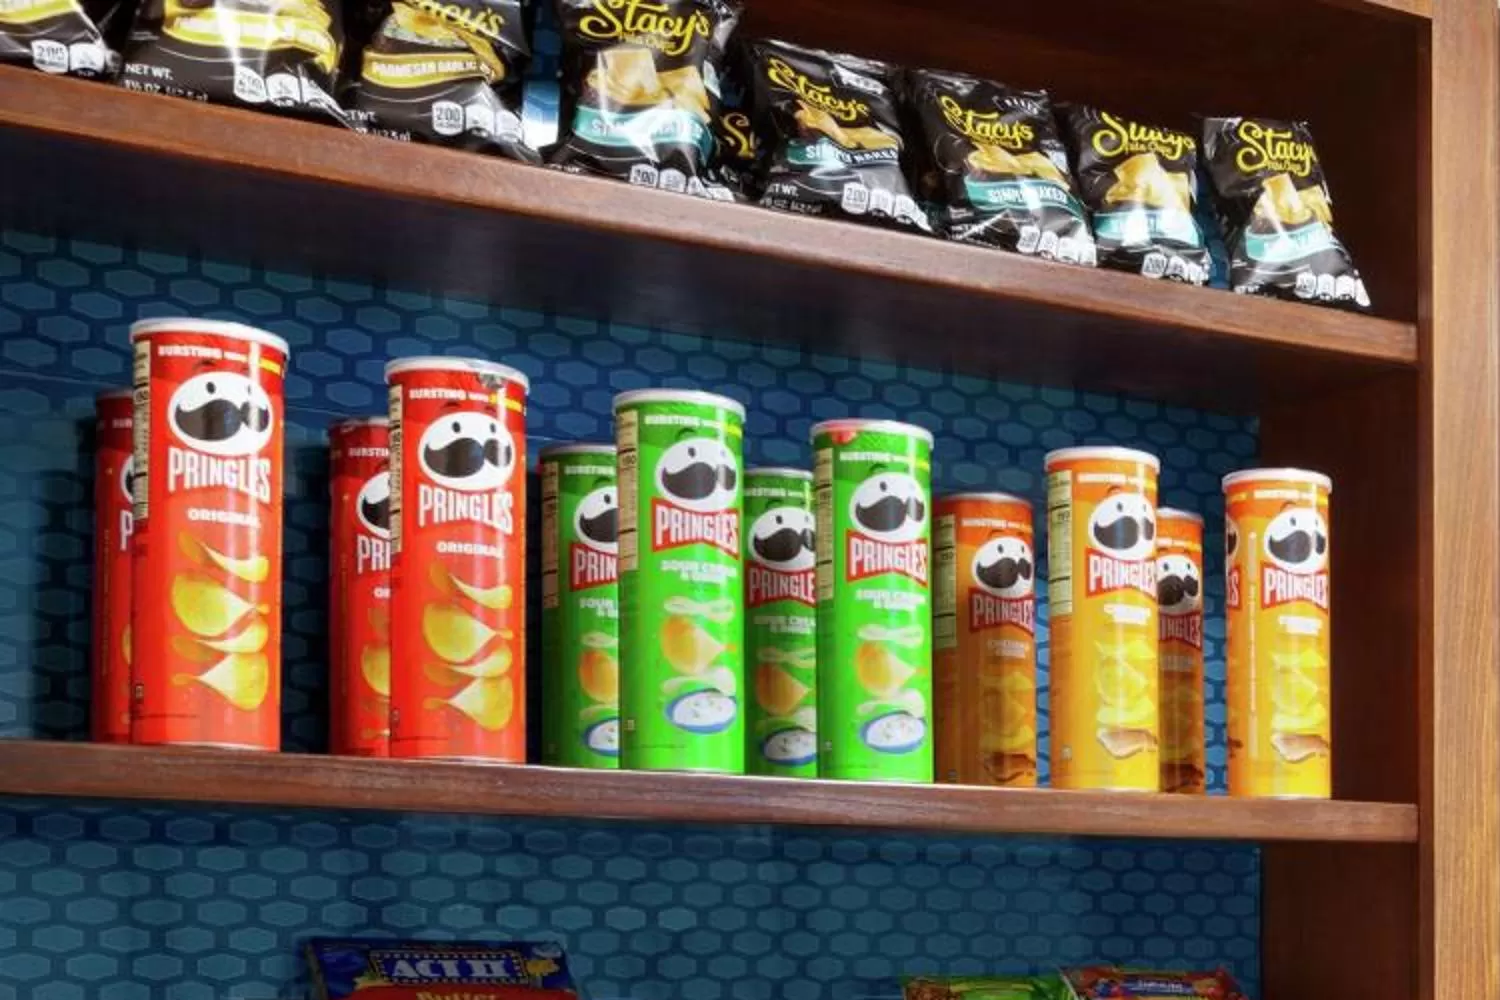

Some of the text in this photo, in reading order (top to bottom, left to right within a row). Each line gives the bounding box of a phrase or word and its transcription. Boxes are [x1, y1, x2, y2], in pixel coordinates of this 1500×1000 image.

[579, 0, 711, 56] Stacy's
[767, 57, 870, 121] Stacy's
[940, 95, 1035, 149] Stacy's
[408, 387, 466, 400] BURSTING
[168, 446, 272, 505] PRINGLES
[418, 483, 514, 535] PRINGLES
[655, 503, 740, 556] PRINGLES
[436, 540, 504, 559] ORIGINAL
[574, 547, 618, 585] PRIN
[851, 534, 929, 584] PRINGLES
[750, 566, 816, 605] PRINGLE
[1088, 554, 1156, 601] PRINGLES
[393, 959, 510, 978] ACT II
